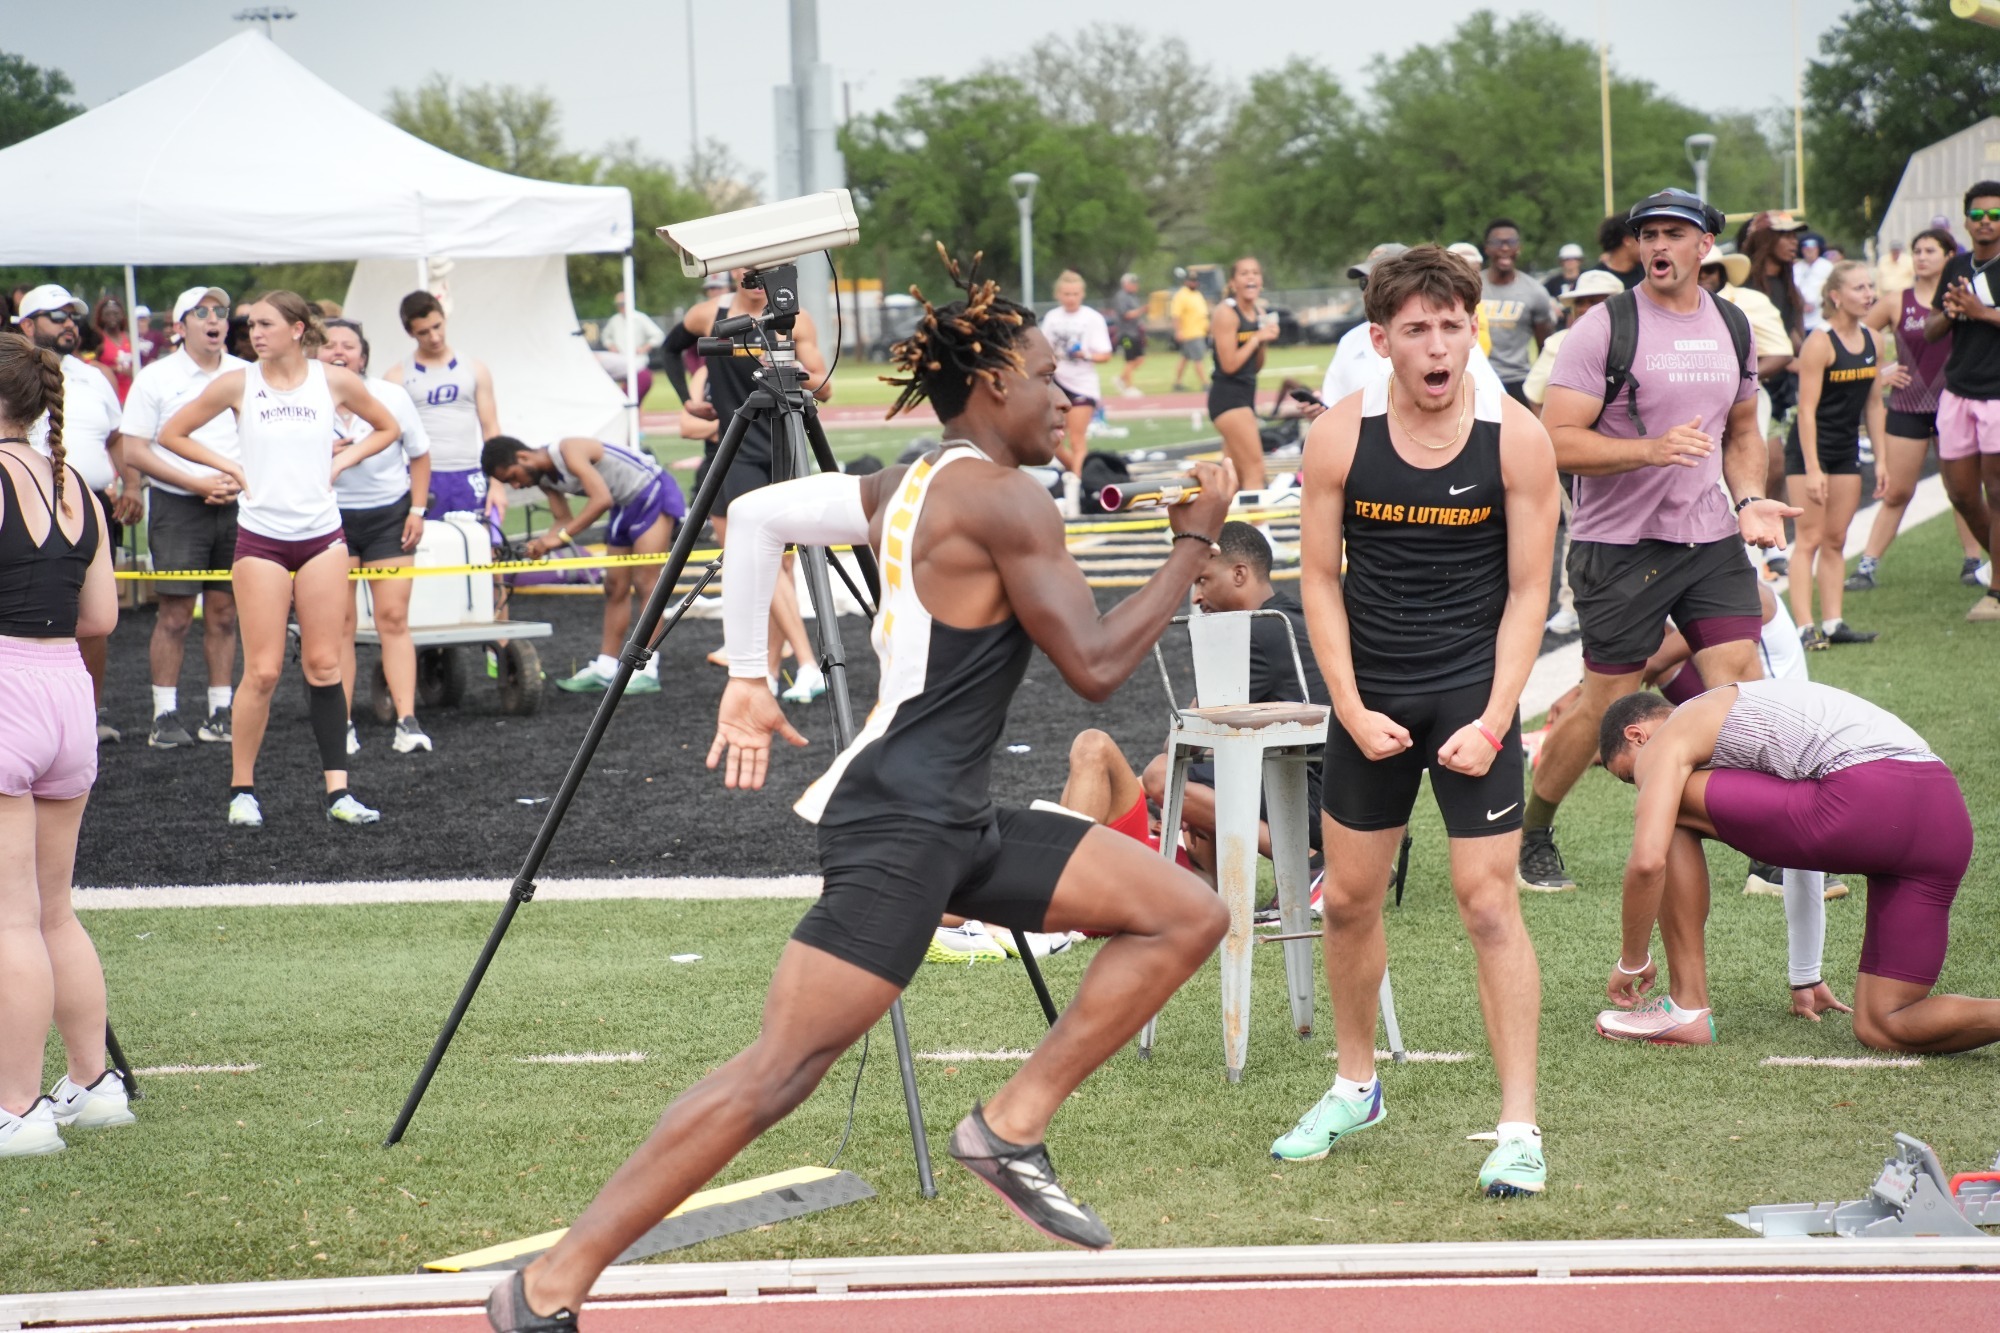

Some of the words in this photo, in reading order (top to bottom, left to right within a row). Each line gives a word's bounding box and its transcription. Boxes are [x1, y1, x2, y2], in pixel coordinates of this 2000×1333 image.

[1646, 353, 1738, 371] MCMURRY
[1669, 372, 1730, 383] UNIVERSITY
[1355, 500, 1405, 523] TEXAS
[1407, 506, 1491, 526] LUTHERAN
